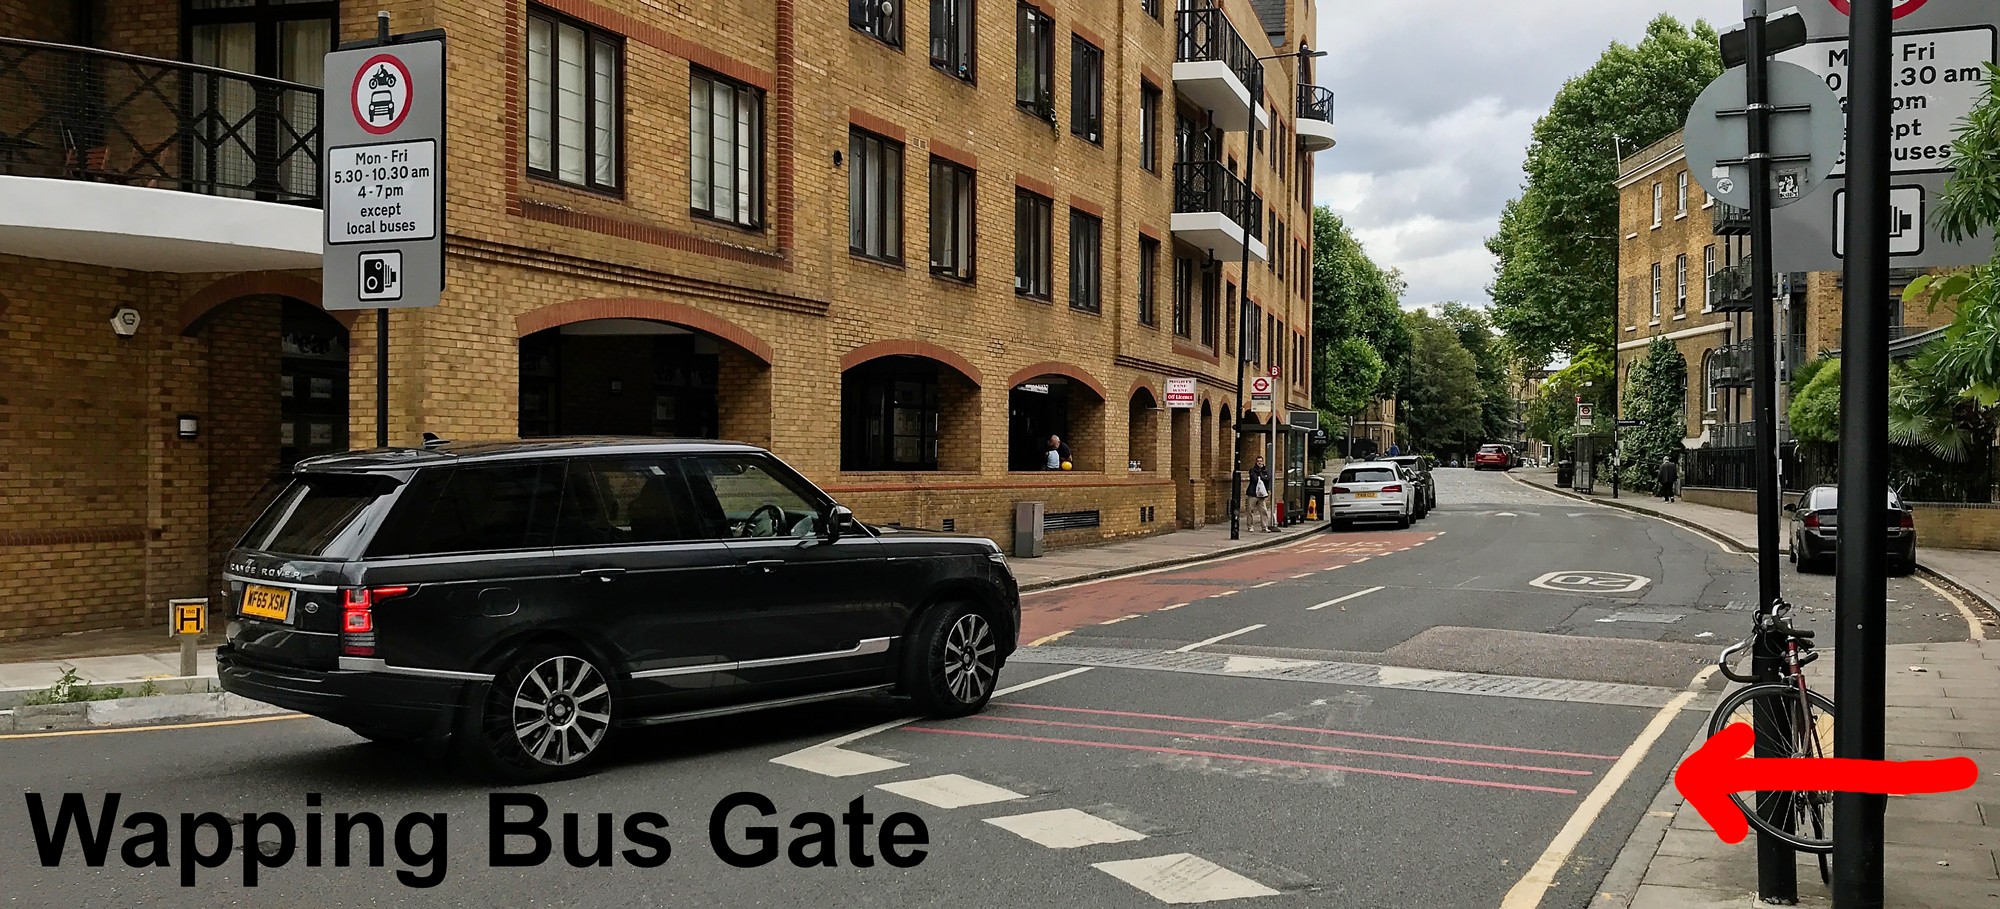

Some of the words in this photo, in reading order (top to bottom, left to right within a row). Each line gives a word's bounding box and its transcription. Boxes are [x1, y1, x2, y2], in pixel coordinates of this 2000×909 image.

[1903, 42, 1935, 61] Fri
[1893, 66, 1937, 86] .30
[1944, 67, 1981, 83] am
[1891, 95, 1927, 114] pm
[355, 152, 381, 165] Mon
[391, 149, 408, 162] Fri
[1891, 144, 1951, 161] uses
[334, 169, 363, 183] 5.30
[372, 166, 409, 180] 10.30
[411, 167, 430, 178] am
[357, 186, 367, 198] 4
[375, 185, 383, 197] 7
[385, 186, 404, 199] pm
[360, 203, 402, 218] except
[347, 221, 376, 235] local
[379, 220, 416, 233] buses
[1271, 367, 1278, 376] B
[261, 567, 302, 581] ROVER
[180, 607, 200, 631] H
